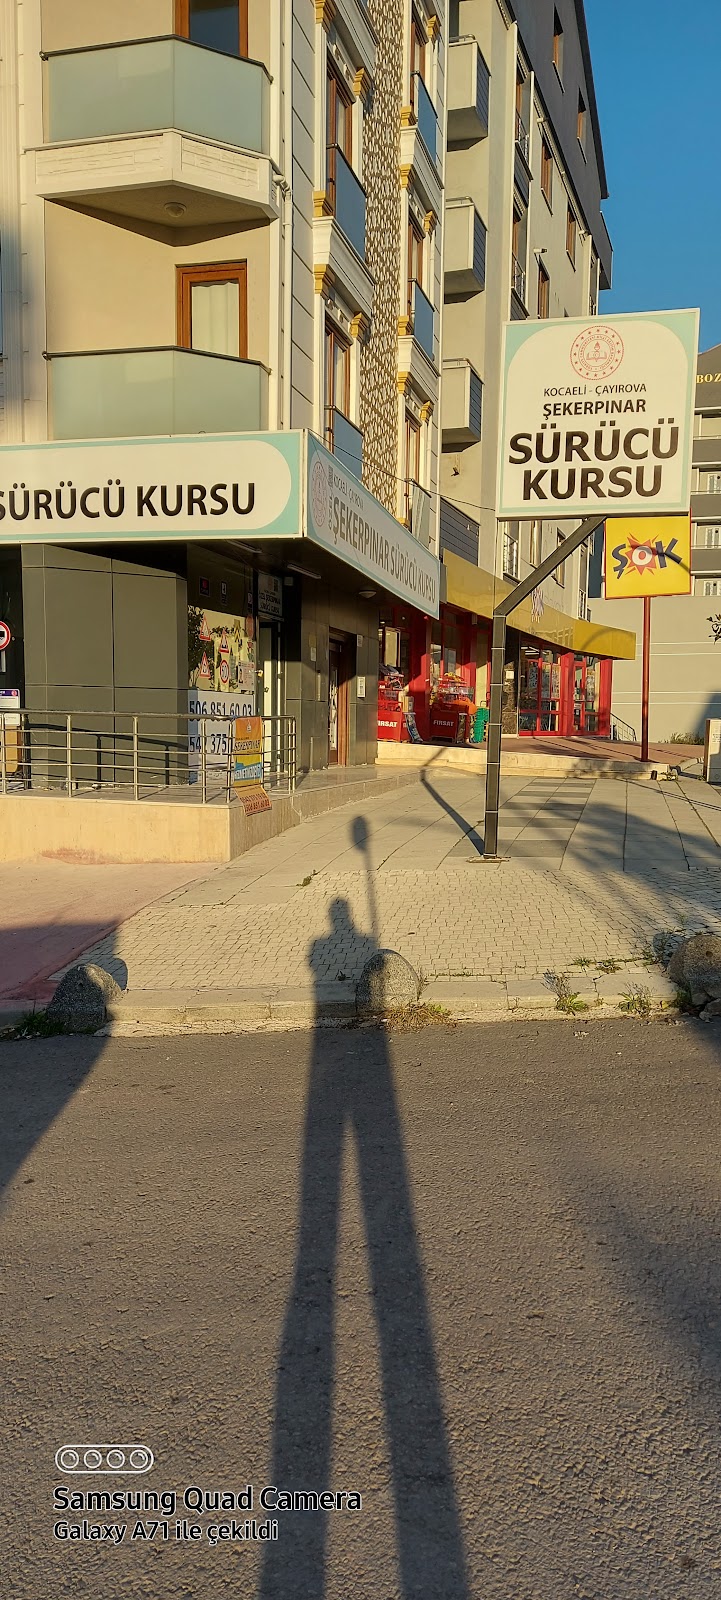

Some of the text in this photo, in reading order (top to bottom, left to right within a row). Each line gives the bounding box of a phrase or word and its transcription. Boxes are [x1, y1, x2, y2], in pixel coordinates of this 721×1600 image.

[543, 384, 587, 397] KOCAELİ
[595, 383, 647, 396] ÇAYIROVA
[543, 399, 646, 420] ŞEKERPINAR
[509, 417, 679, 465] SÜRÜCÜ
[0, 478, 255, 521] ÜRÜCÜ KURSU
[522, 465, 663, 500] KURSU
[333, 497, 389, 572] ŞEKERPINAR
[390, 544, 417, 592] SÜRÜCÜ
[611, 537, 683, 579] ŞOK
[378, 720, 398, 728] IRSAT
